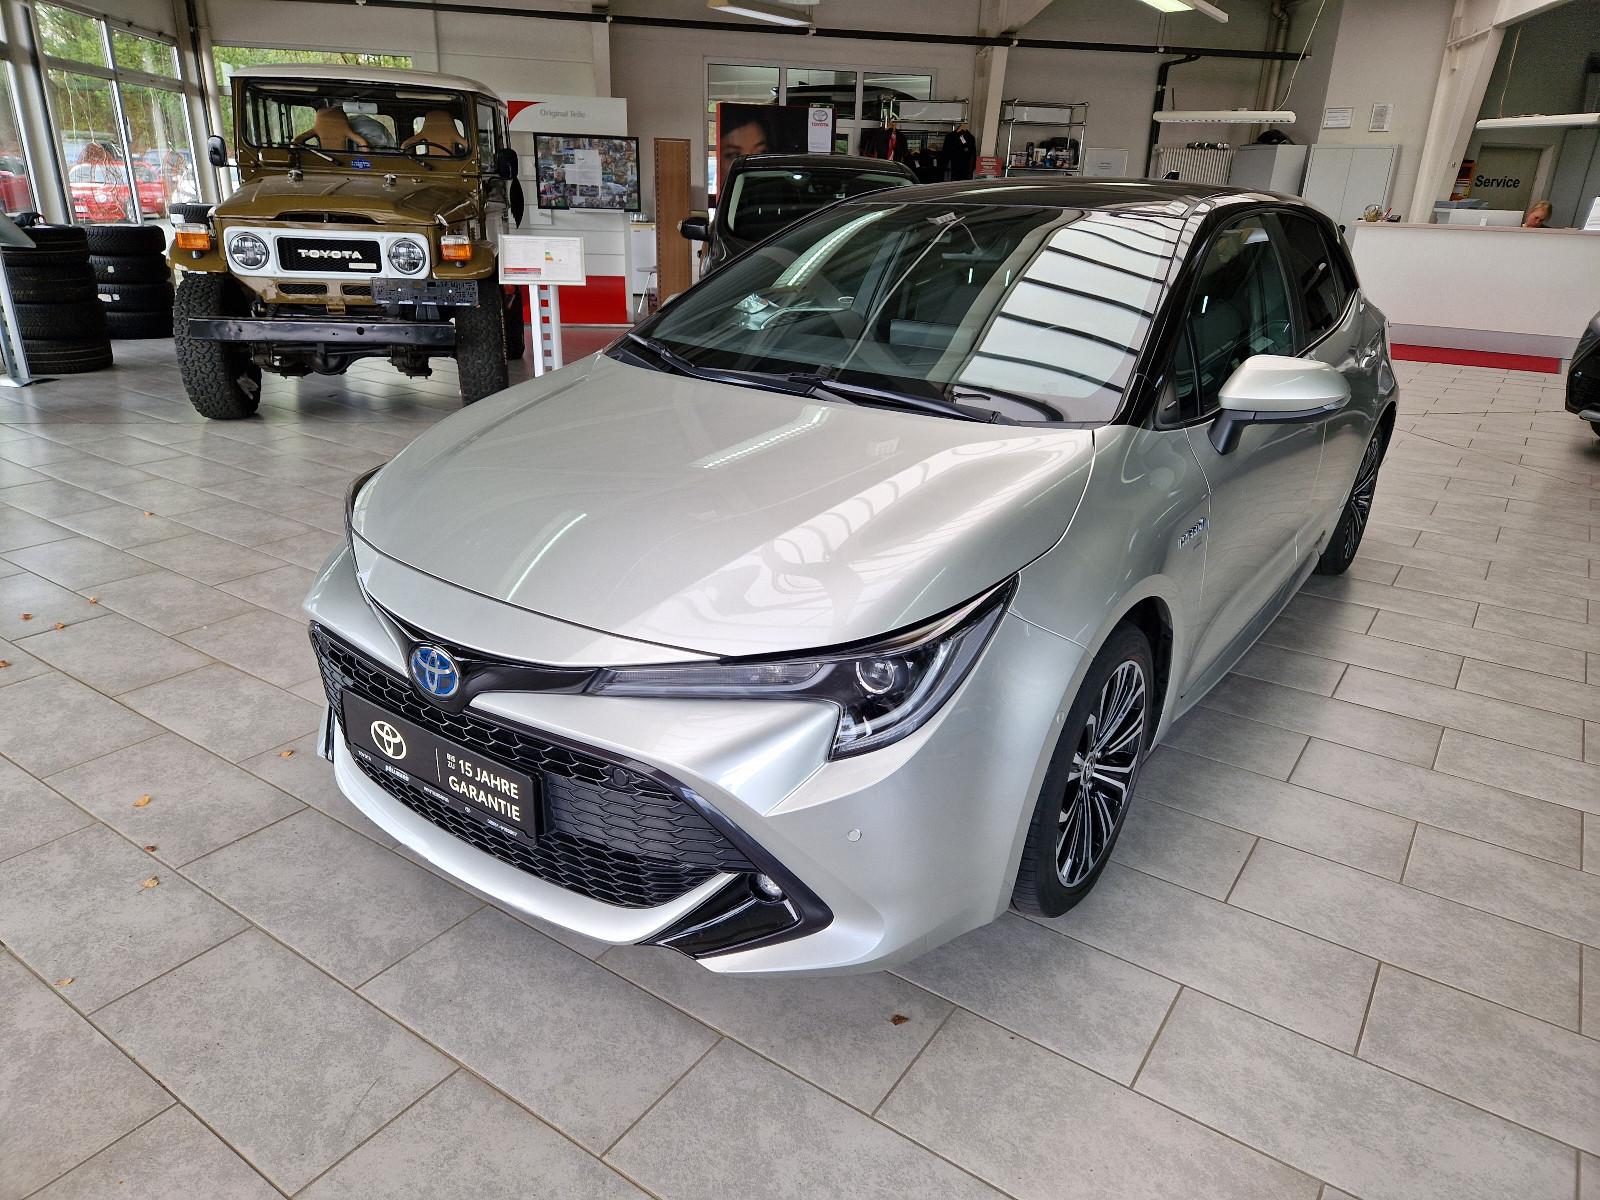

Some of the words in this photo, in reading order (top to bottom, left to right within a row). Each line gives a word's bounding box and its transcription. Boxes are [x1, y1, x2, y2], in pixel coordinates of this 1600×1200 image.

[540, 109, 569, 119] Original
[1474, 174, 1520, 189] Service
[297, 249, 363, 260] TOYOTA
[458, 759, 473, 778] 15
[474, 767, 519, 800] JAHRE
[448, 775, 521, 822] GARANTIE
